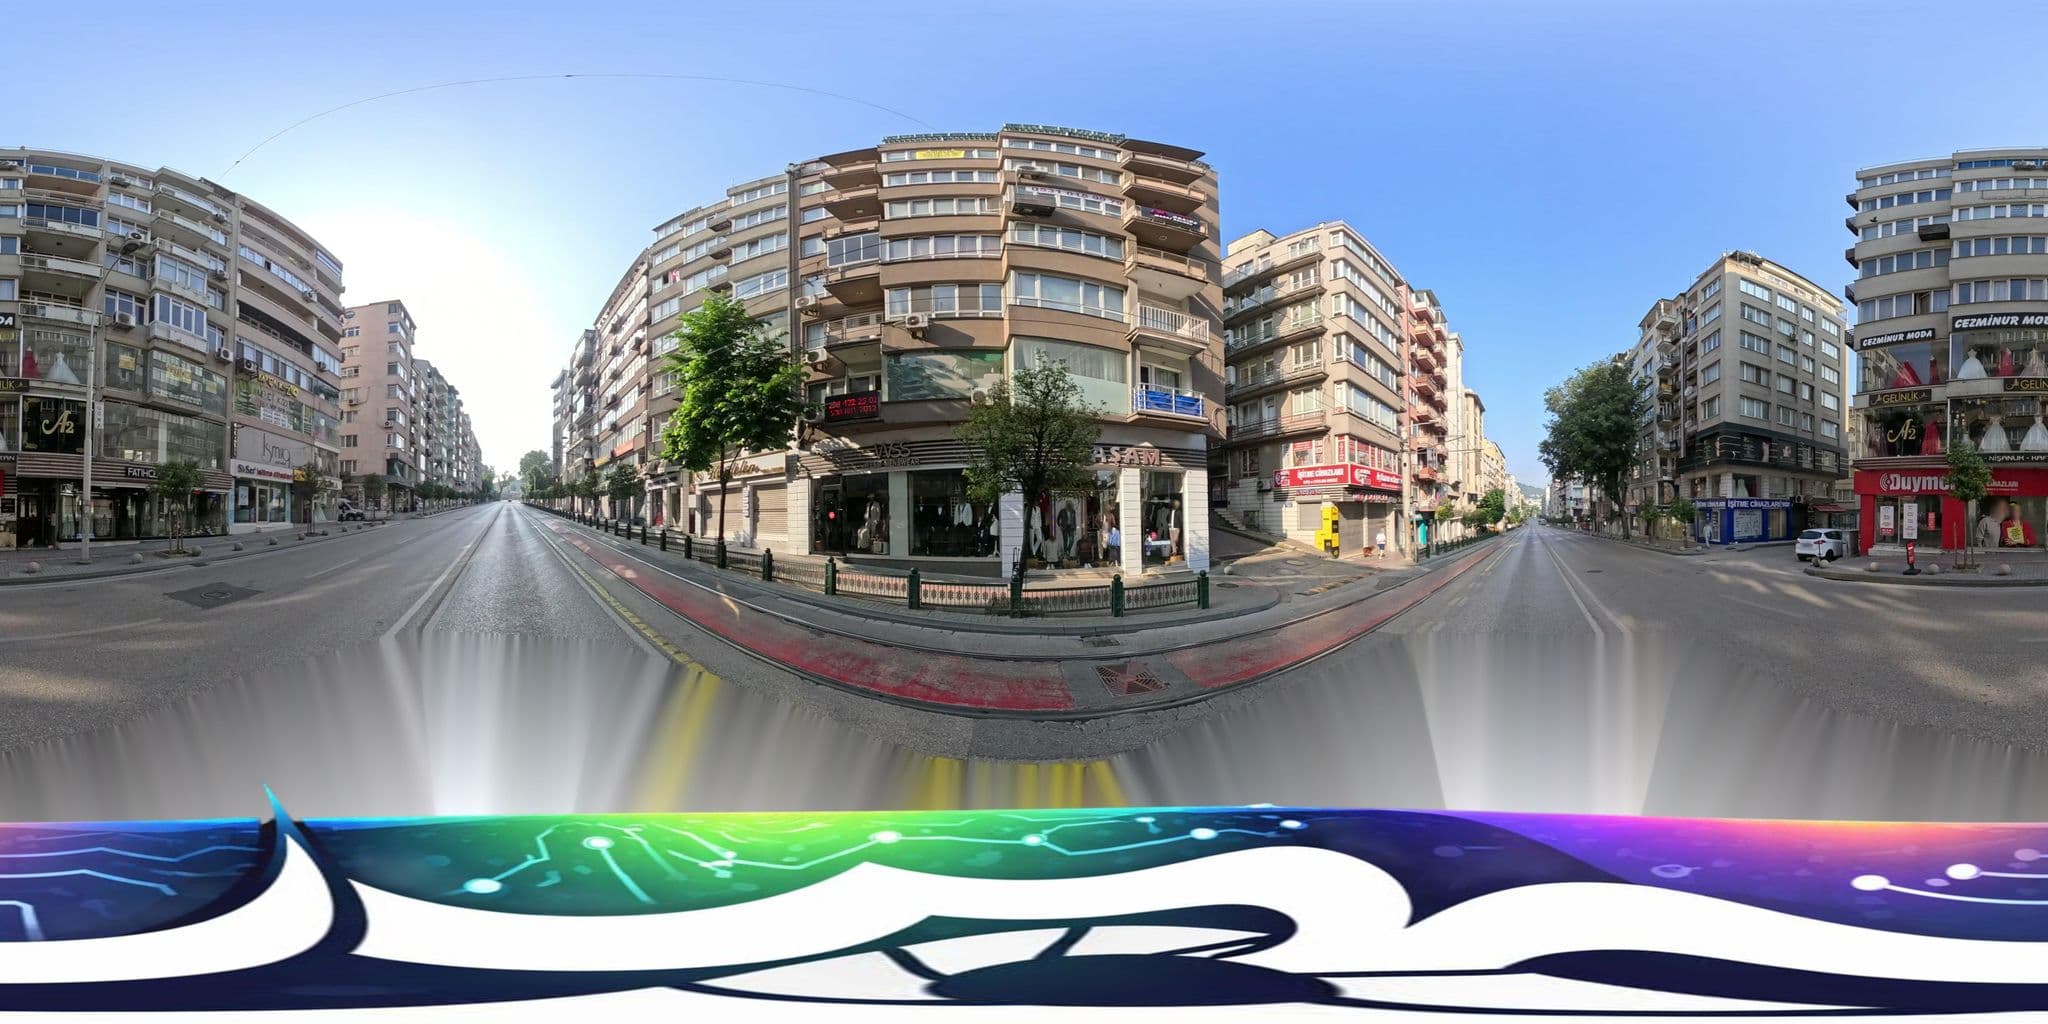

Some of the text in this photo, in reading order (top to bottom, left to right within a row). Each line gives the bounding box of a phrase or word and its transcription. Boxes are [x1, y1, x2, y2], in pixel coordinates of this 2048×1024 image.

[1955, 314, 2019, 329] CEZMİNUR
[1862, 329, 1933, 347] CEZMİNUR MODA
[1092, 446, 1160, 467] AŞAM
[1728, 499, 1749, 509] İŞİTME
